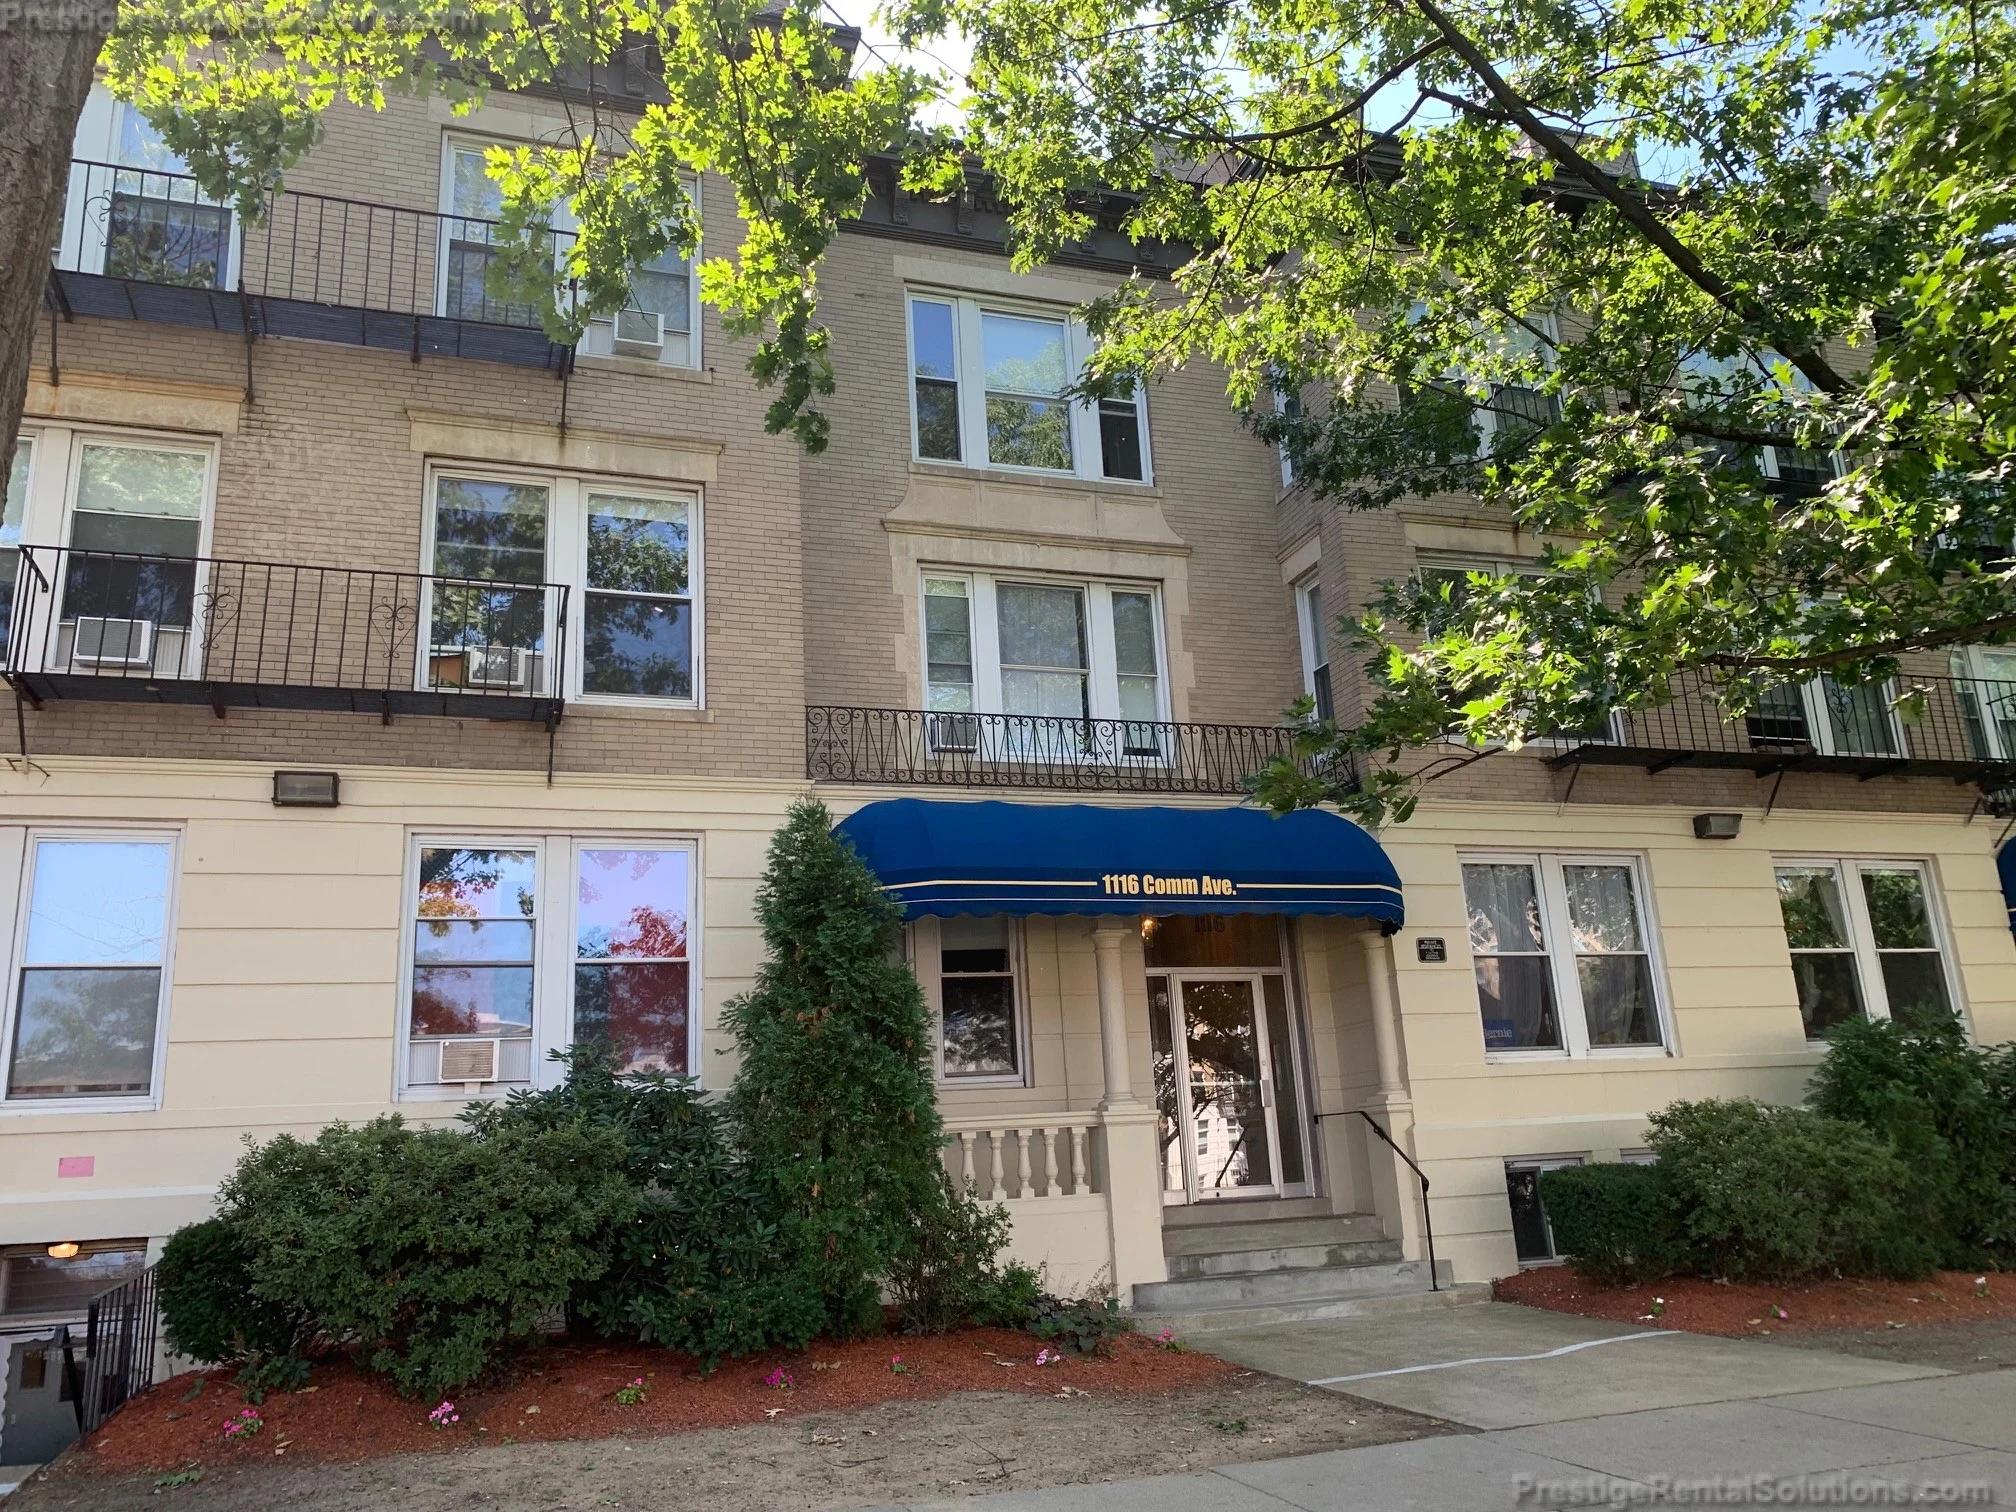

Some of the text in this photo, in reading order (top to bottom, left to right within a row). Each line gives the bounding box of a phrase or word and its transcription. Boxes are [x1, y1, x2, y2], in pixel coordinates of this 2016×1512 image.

[1102, 874, 1237, 896] 1116 Comm Ave.
